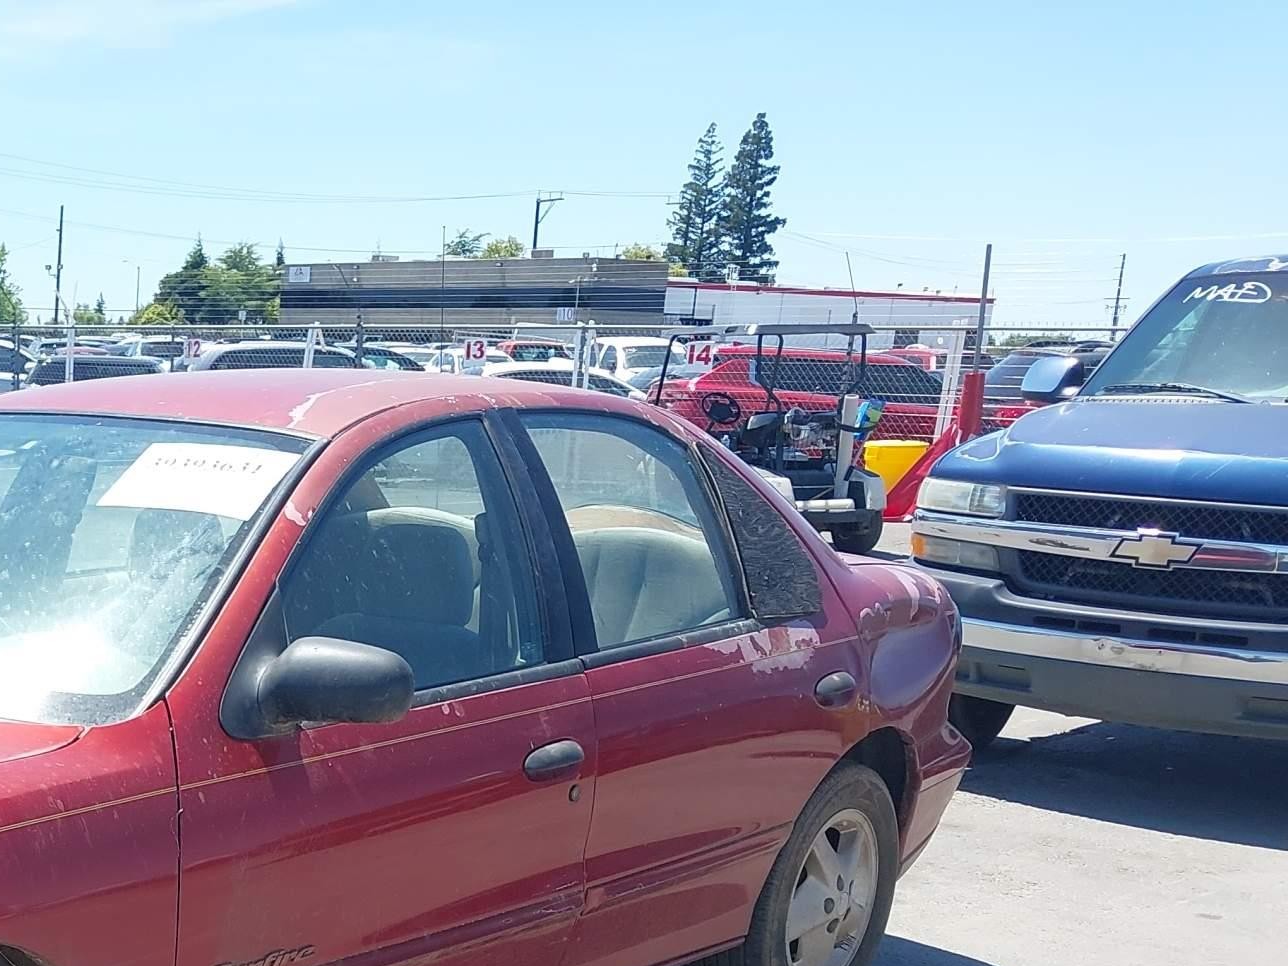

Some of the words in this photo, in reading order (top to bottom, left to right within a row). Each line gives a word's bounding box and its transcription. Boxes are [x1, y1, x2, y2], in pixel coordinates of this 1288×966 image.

[186, 340, 201, 358] 12
[465, 340, 485, 361] 13
[687, 344, 712, 366] 14
